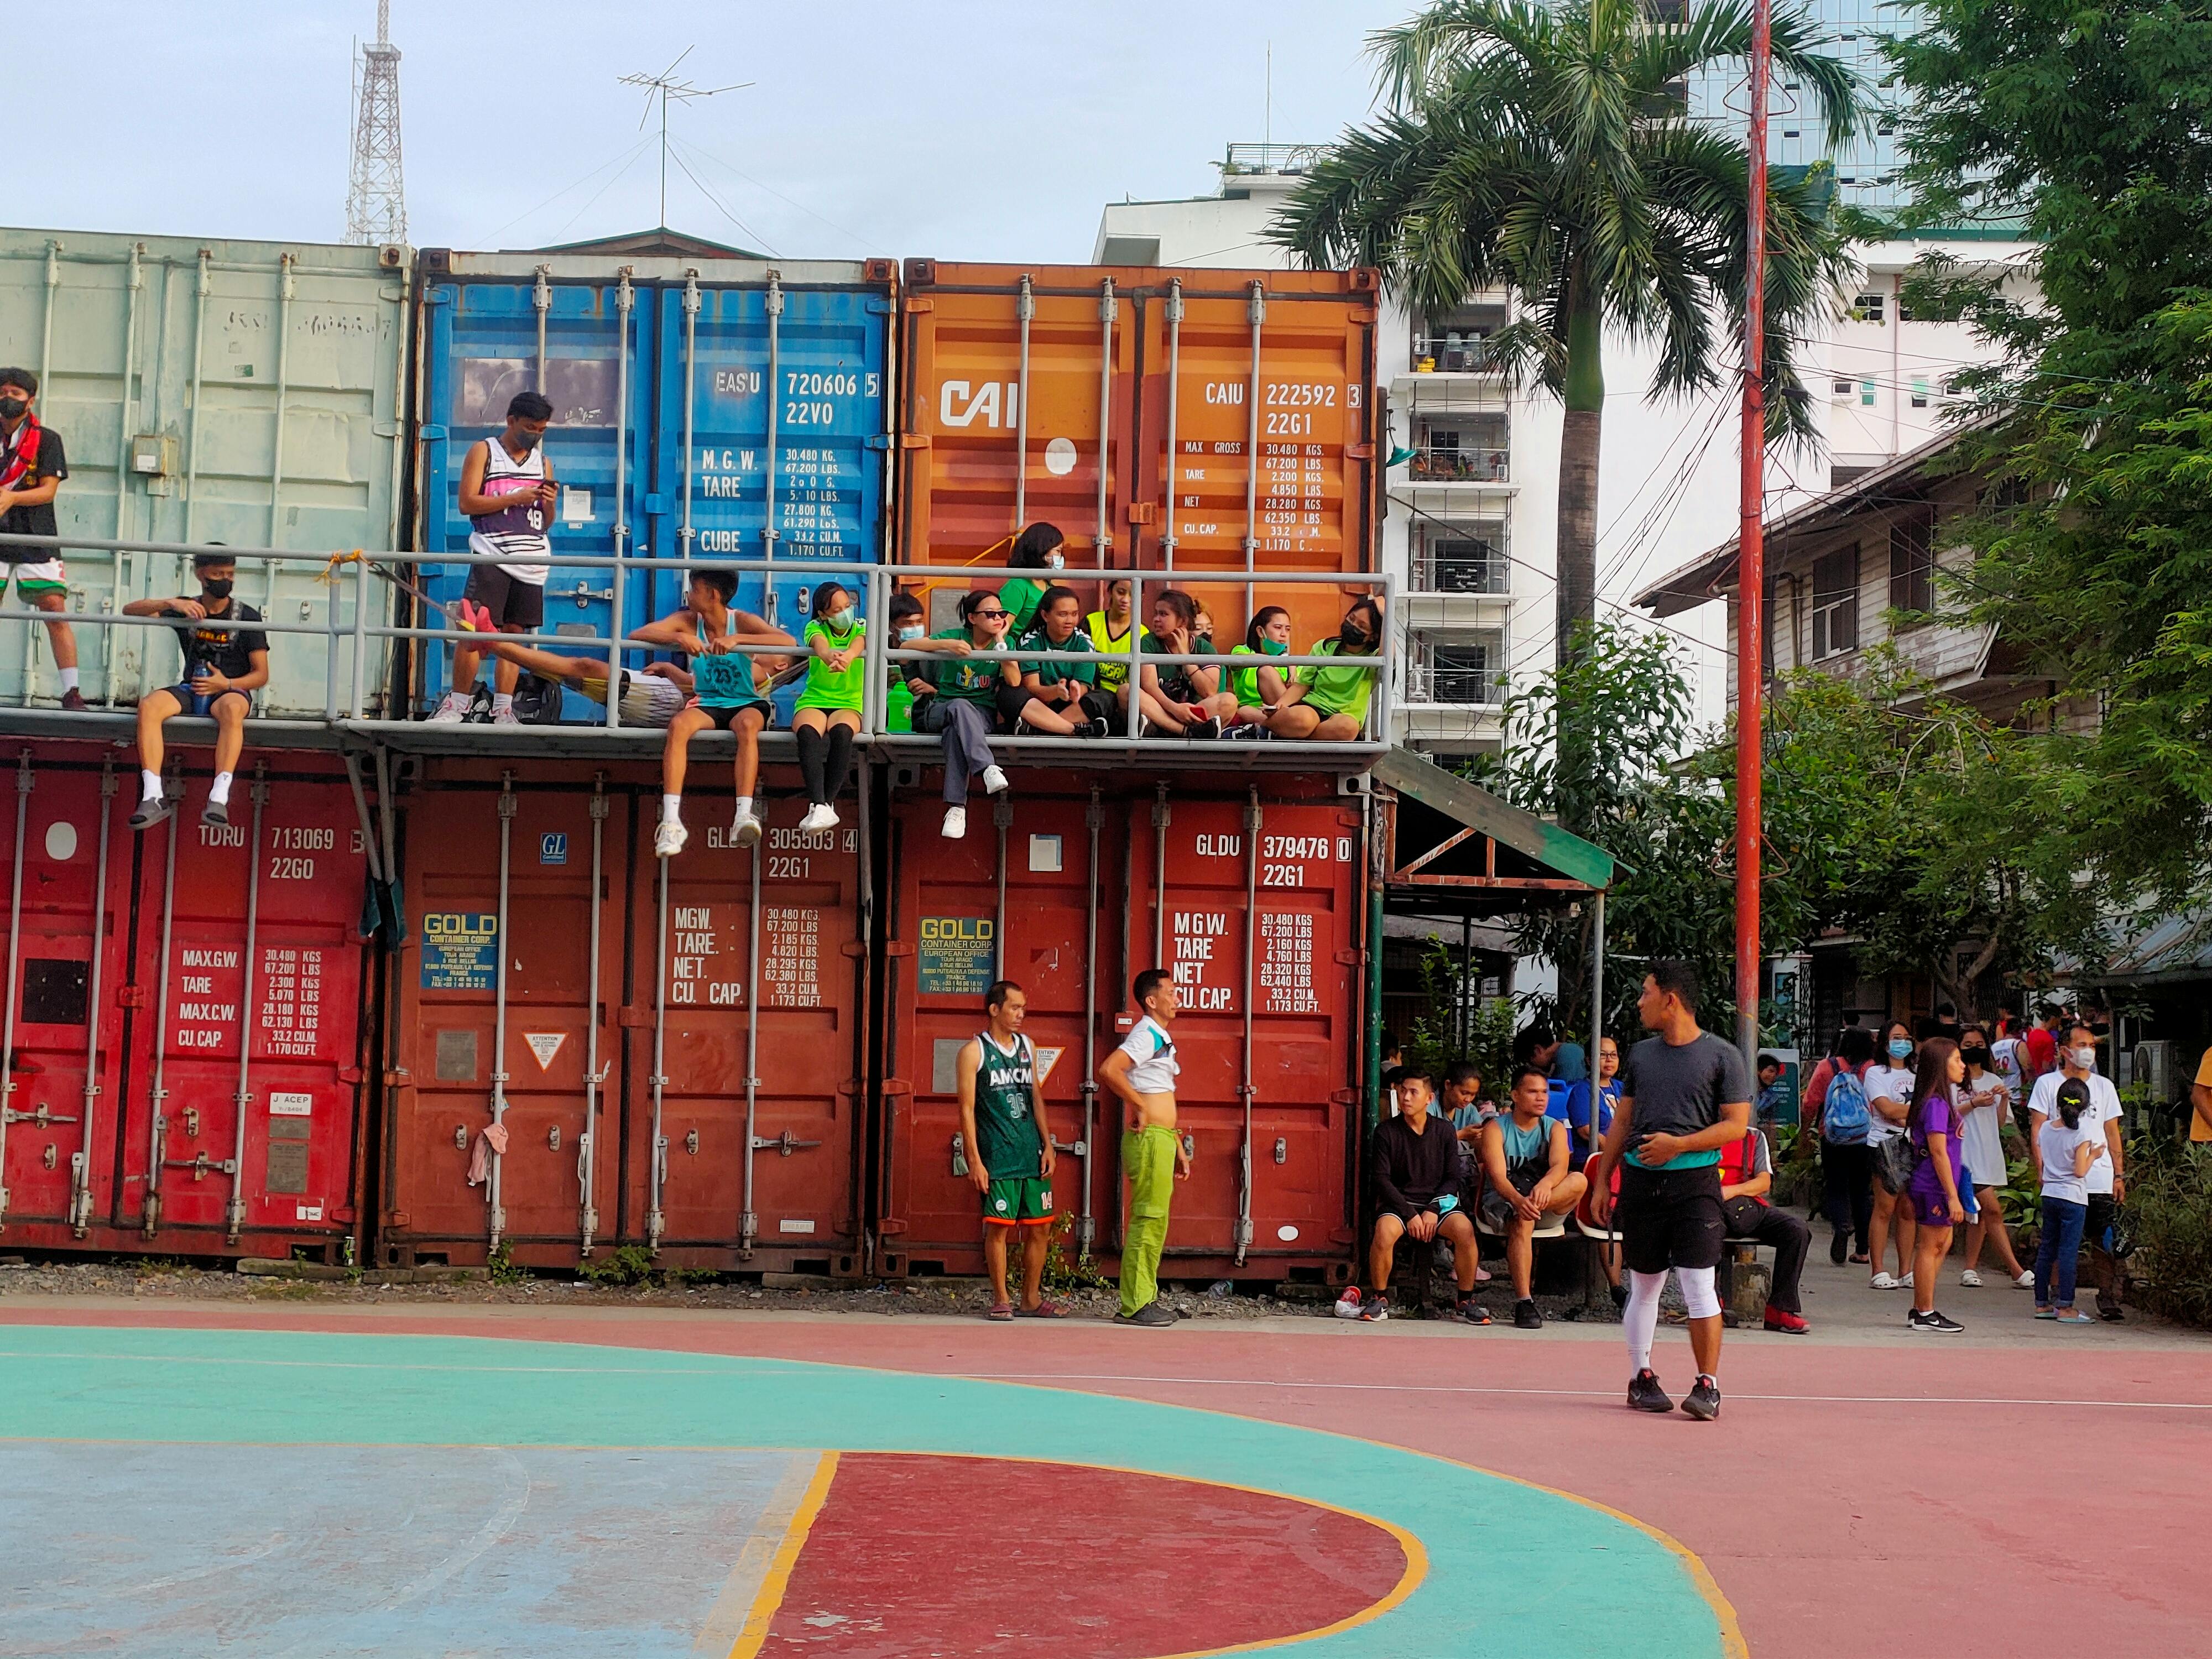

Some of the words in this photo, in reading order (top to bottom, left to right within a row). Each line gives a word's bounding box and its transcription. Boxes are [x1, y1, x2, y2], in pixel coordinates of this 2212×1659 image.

[716, 371, 760, 393] EASU
[787, 373, 857, 395] 720606
[866, 374, 879, 397] 5
[940, 380, 1019, 429] CAI
[1206, 383, 1244, 405] CAIU
[1266, 384, 1336, 407] 222592
[1349, 385, 1360, 407] 3
[1266, 412, 1312, 435] 22G1
[1185, 442, 1204, 453] MAX
[1214, 442, 1241, 454] GROSS
[1185, 469, 1205, 480] TARE
[702, 476, 741, 498] TARE
[1184, 496, 1200, 508] NET
[700, 530, 740, 552] CUBE
[794, 530, 815, 542] 33.2
[1270, 526, 1291, 536] 33.2
[197, 825, 246, 847] TDRU
[270, 827, 334, 851] 713069
[542, 834, 565, 855] GL
[707, 827, 749, 849] GL
[769, 827, 834, 851] 305503
[843, 830, 857, 853] 4
[1196, 834, 1240, 857] GLDU
[1263, 836, 1329, 859] 379476
[768, 857, 810, 878] 22G1
[1263, 864, 1304, 887] 22G1
[424, 914, 498, 935] GOLD
[675, 907, 712, 930] MGW.
[1295, 914, 1313, 926] KGS
[921, 919, 993, 940] GOLD
[1295, 926, 1312, 938] LBS
[675, 932, 719, 955] TARE.
[921, 940, 968, 948] CONTAINER
[1174, 937, 1214, 960] TARE
[1295, 940, 1312, 951] KGS
[302, 950, 322, 963] KGS
[1295, 951, 1312, 963] LBS
[301, 963, 321, 976] LBS
[673, 957, 708, 979] NET.
[1173, 962, 1205, 984] NET
[1294, 964, 1312, 976] KGS
[181, 976, 212, 994] TARE
[300, 977, 320, 990] KGS
[1293, 975, 1311, 988] LBS
[300, 990, 320, 1003] LBS
[672, 982, 697, 1004] CU.
[709, 982, 744, 1005] CAP.
[775, 983, 796, 995] 33.2
[1199, 987, 1233, 1011] CAP.
[1271, 988, 1291, 1000] 33.2
[299, 1004, 319, 1017] KGS
[299, 1016, 318, 1029] LBS
[272, 1030, 292, 1042] 33.2
[284, 1095, 309, 1104] ACEP
